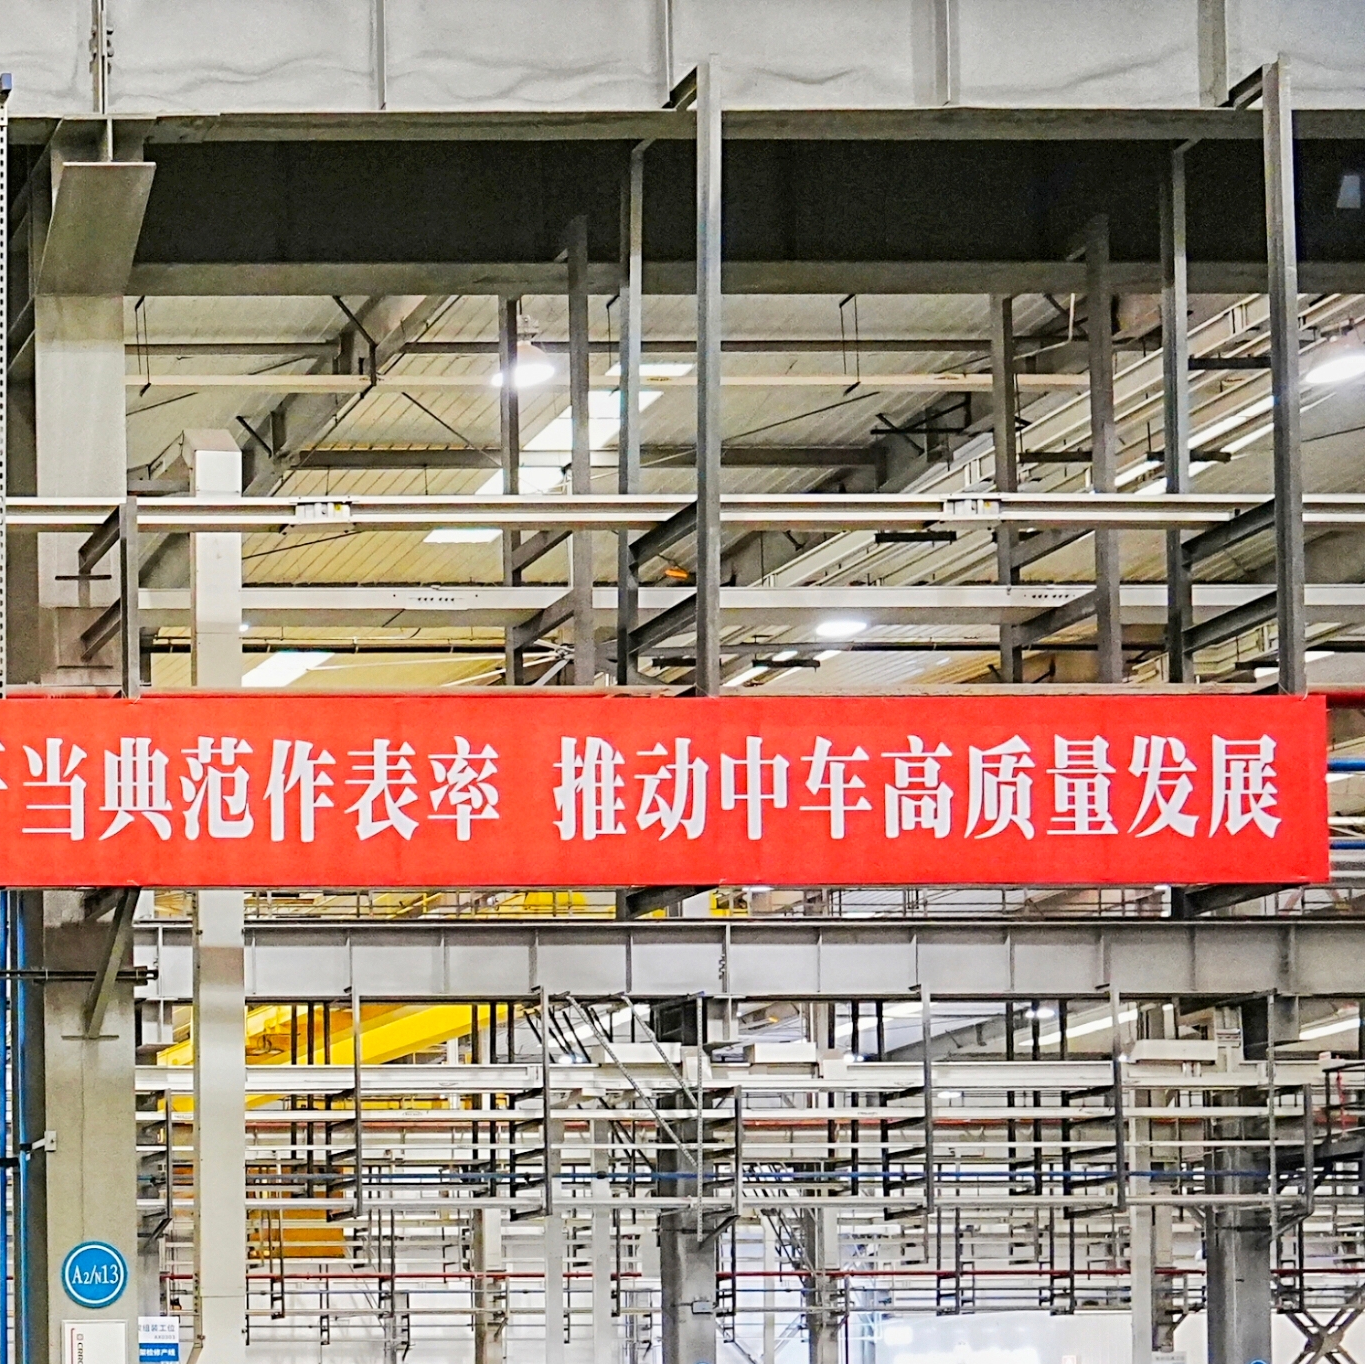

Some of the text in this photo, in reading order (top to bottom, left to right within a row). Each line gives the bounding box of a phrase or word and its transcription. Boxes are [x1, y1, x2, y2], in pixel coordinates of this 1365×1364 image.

[553, 735, 1281, 840] 推动中车高质量发展
[72, 1263, 119, 1286] A2/N13
